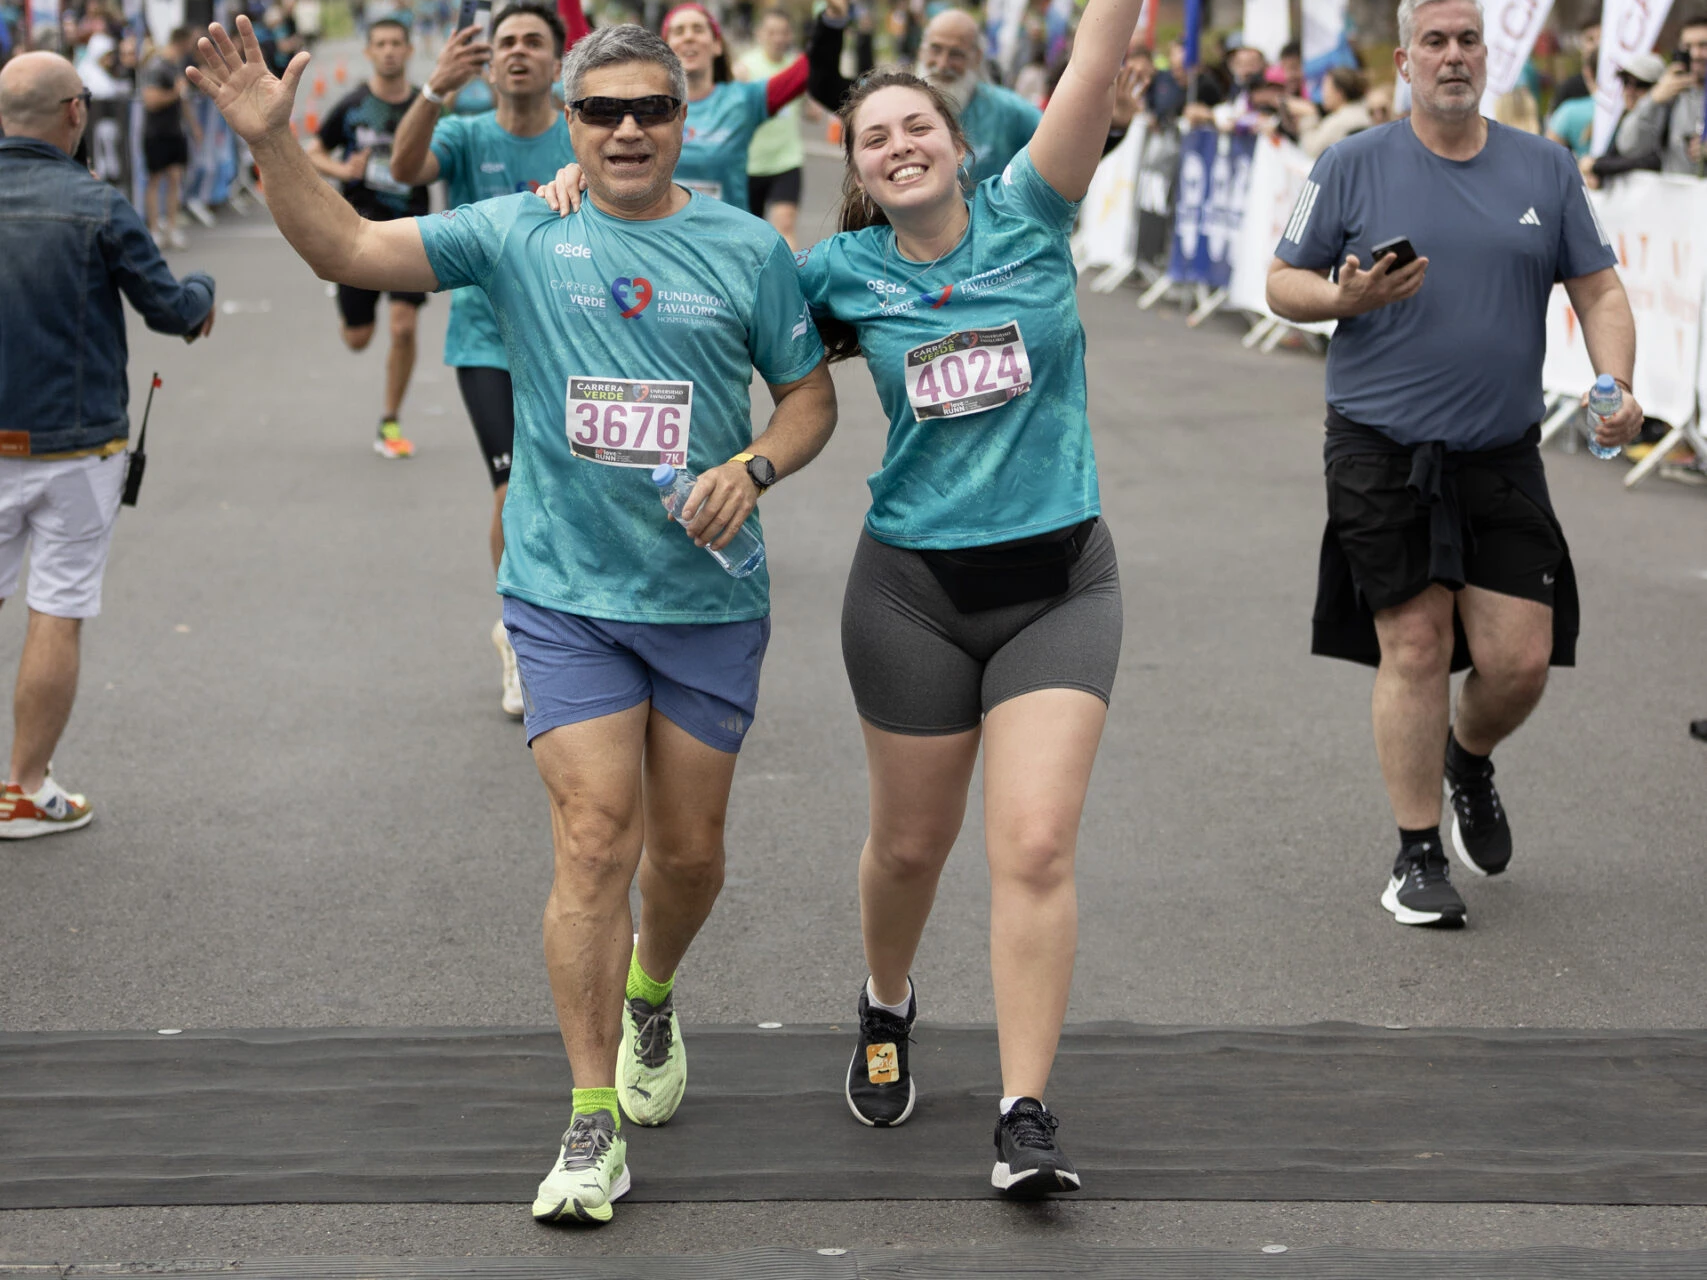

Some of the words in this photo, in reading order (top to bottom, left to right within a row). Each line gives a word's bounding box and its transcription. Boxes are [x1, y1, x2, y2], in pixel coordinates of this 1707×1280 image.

[555, 243, 592, 259] osde
[866, 279, 907, 295] osde
[569, 293, 607, 308] VERDE
[657, 290, 728, 308] FUNDACIÓN
[657, 302, 718, 318] FAVALORO
[880, 300, 917, 317] VERDE
[913, 338, 955, 359] CARRERA
[919, 343, 956, 363] VERDE
[915, 345, 1023, 403] 4024
[577, 382, 625, 393] CARRERA
[583, 390, 624, 401] VERDE
[575, 402, 681, 450] 3676
[665, 453, 680, 463] 7K
